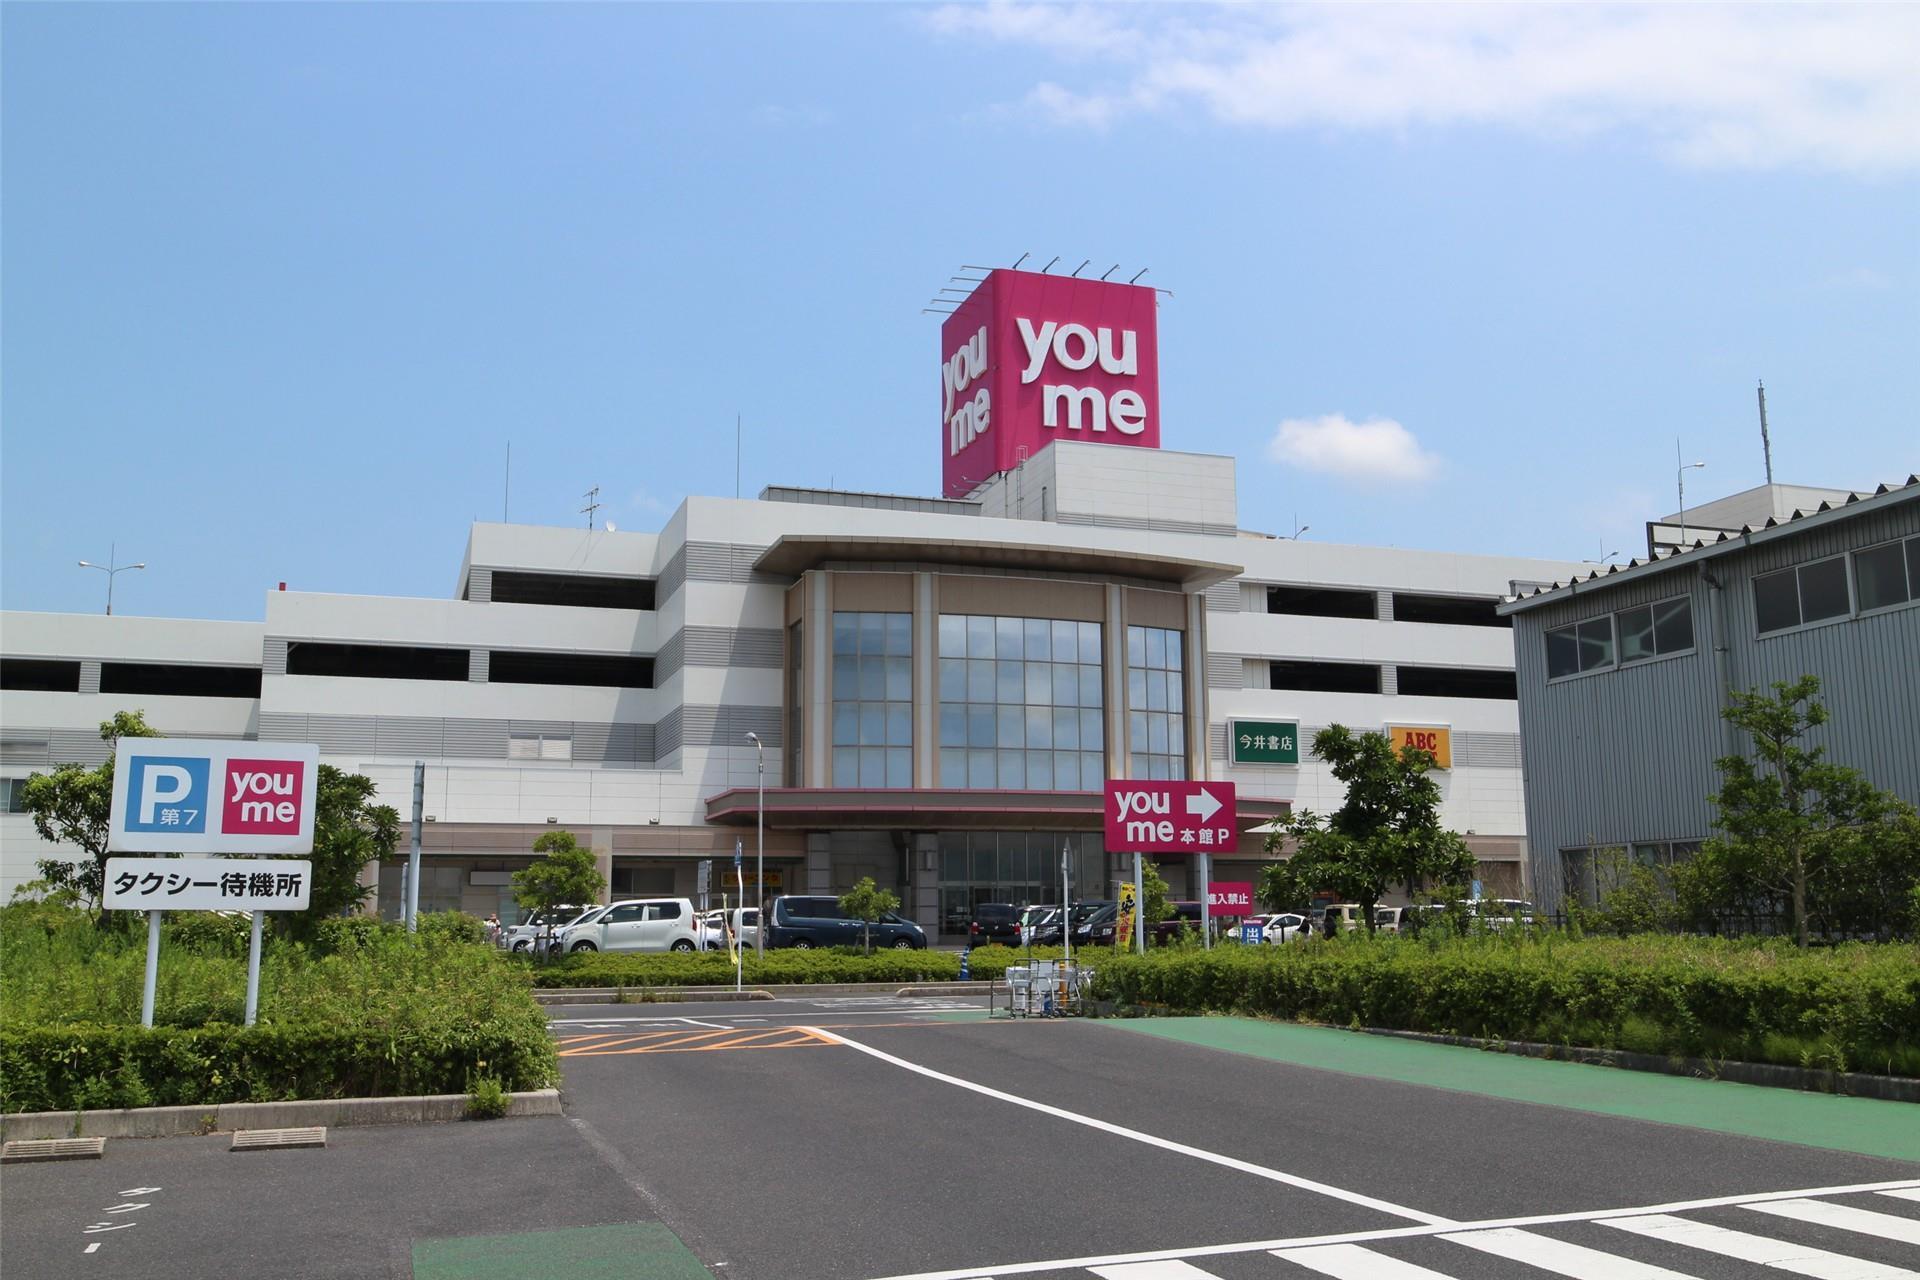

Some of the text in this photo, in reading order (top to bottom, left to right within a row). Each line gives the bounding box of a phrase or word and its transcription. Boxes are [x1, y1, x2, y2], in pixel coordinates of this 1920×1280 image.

[1015, 317, 1138, 384] you
[942, 326, 987, 424] you
[950, 387, 991, 457] me
[1043, 384, 1147, 435] me
[1239, 734, 1293, 751] 今井書店
[1405, 732, 1437, 750] ABC
[139, 764, 193, 824] P
[231, 772, 294, 802] you
[160, 808, 198, 827] 第7
[241, 800, 296, 823] me
[1114, 791, 1170, 823] you
[1126, 820, 1175, 843] me
[113, 871, 303, 898] タクシー待機所
